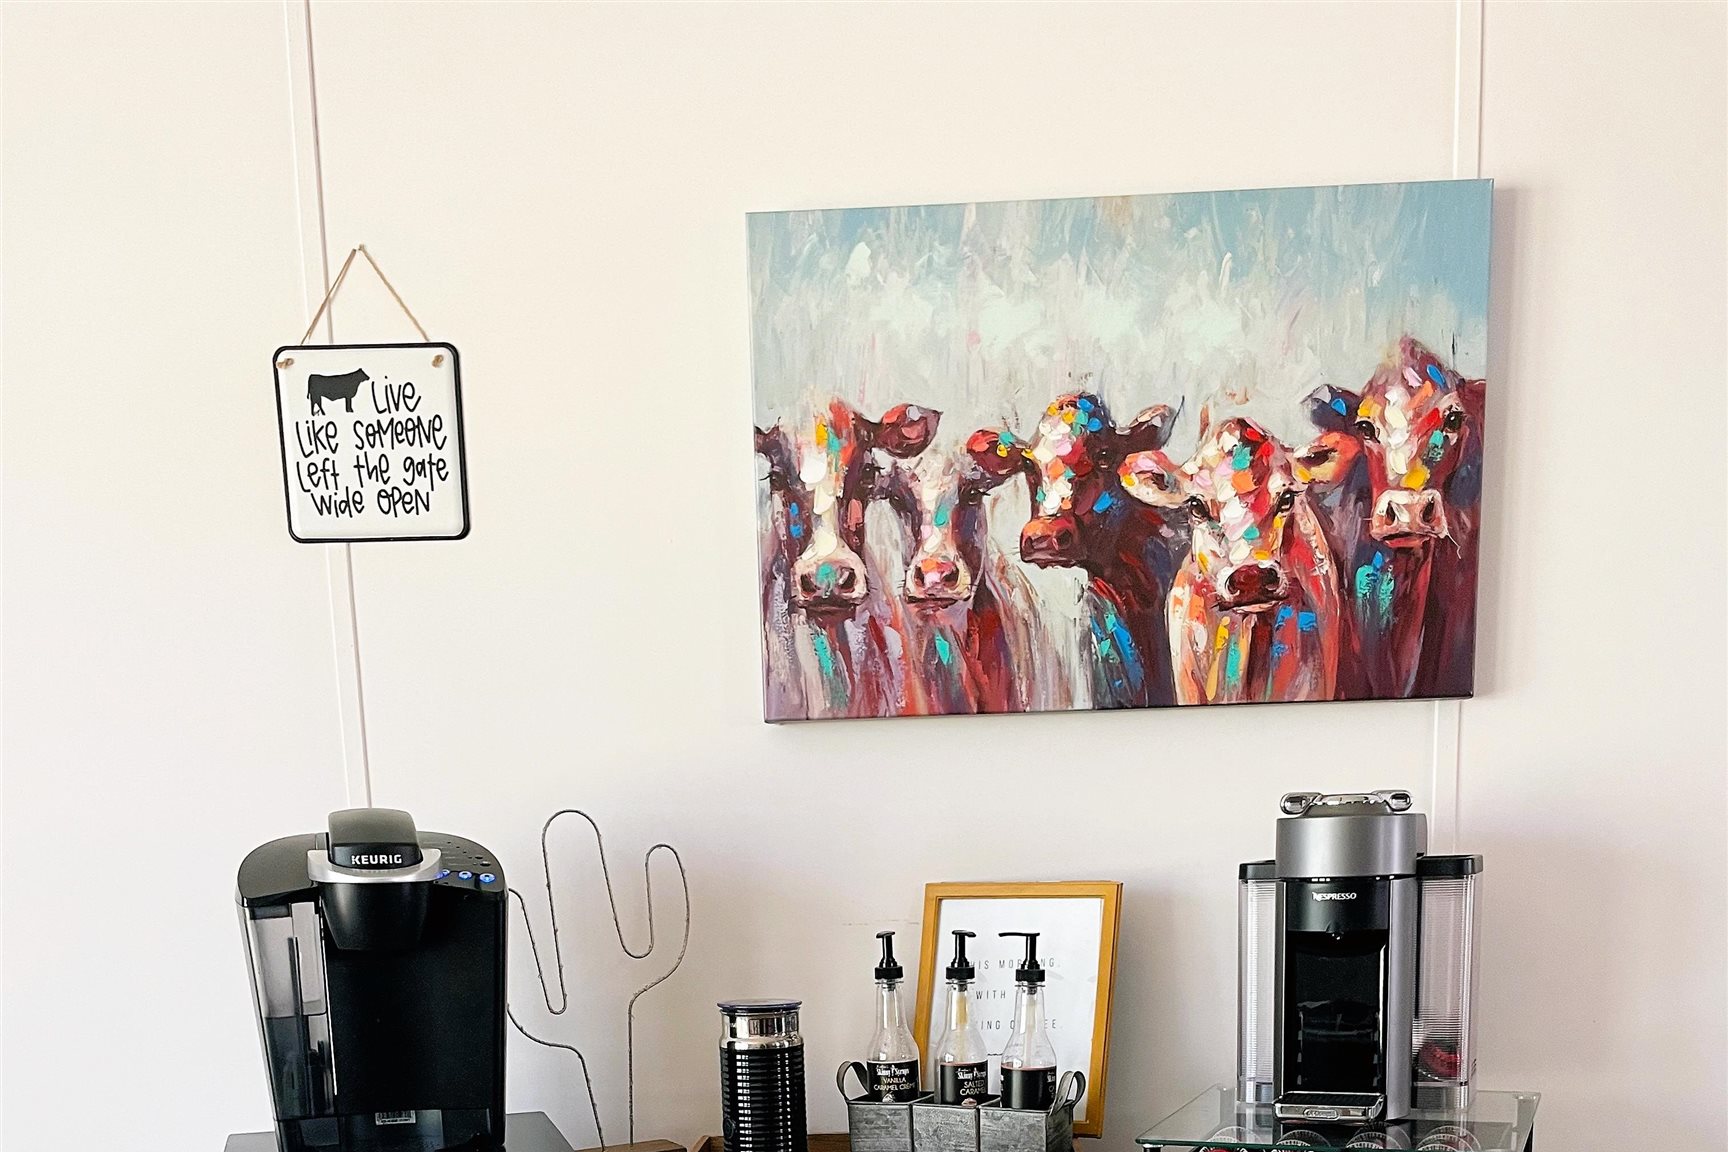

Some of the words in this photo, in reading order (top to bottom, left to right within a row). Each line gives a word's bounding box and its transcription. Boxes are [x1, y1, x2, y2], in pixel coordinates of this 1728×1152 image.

[353, 451, 391, 488] the
[403, 453, 449, 491] gate
[351, 854, 402, 865] KEURIG
[1311, 891, 1357, 901] NESPRESSO
[975, 989, 1006, 1000] WITH
